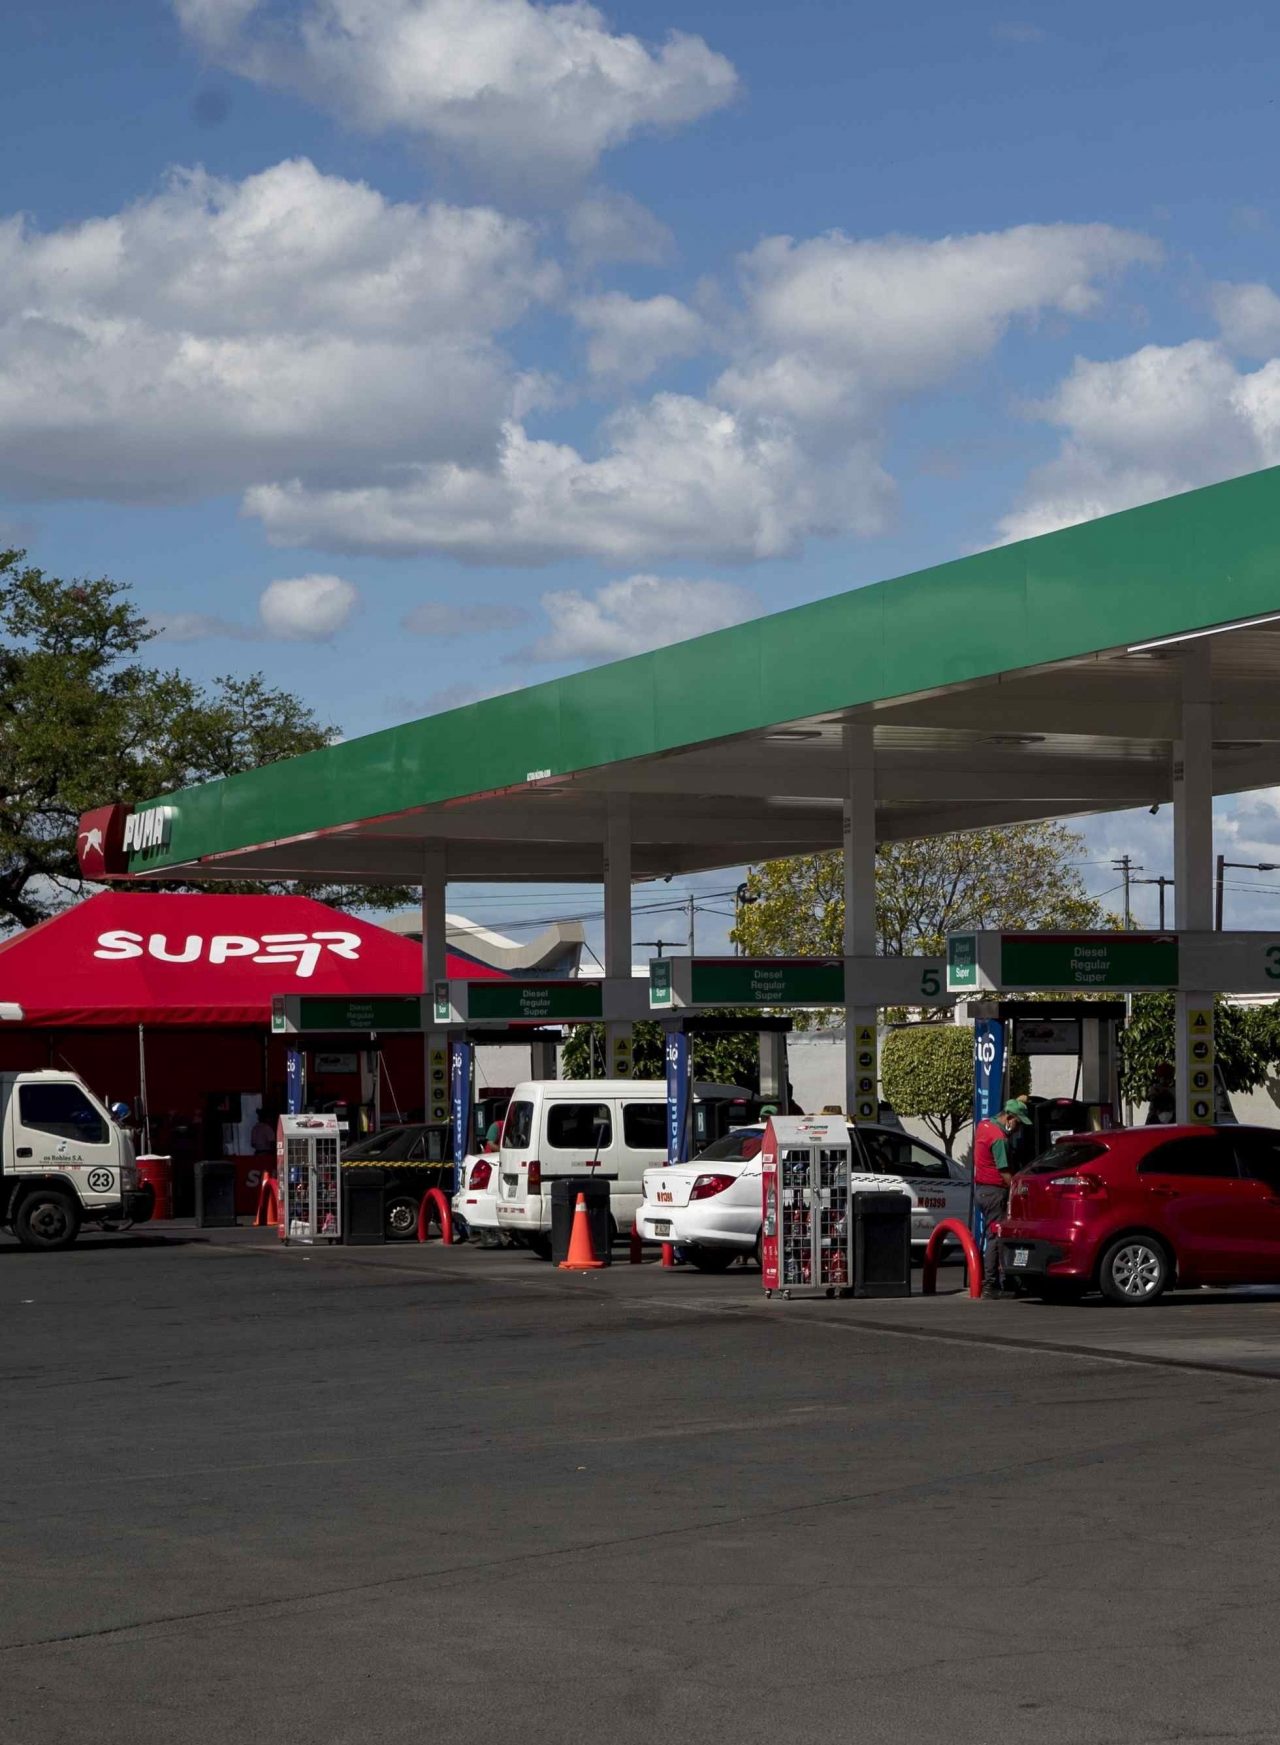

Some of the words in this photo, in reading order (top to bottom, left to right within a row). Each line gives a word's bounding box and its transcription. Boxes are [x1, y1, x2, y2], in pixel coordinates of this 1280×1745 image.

[122, 806, 165, 852] PUMA
[93, 930, 362, 978] SUPER
[1073, 947, 1107, 958] Diesel
[1070, 959, 1111, 971] Regular
[754, 970, 783, 979] Diesel
[1074, 971, 1107, 983] Super
[751, 981, 786, 991] Regular
[921, 969, 940, 997] 5
[522, 989, 549, 998] Diesel
[755, 991, 783, 1001] Super
[519, 999, 551, 1008] Regular
[523, 1008, 549, 1017] Super
[92, 1173, 110, 1187] 23
